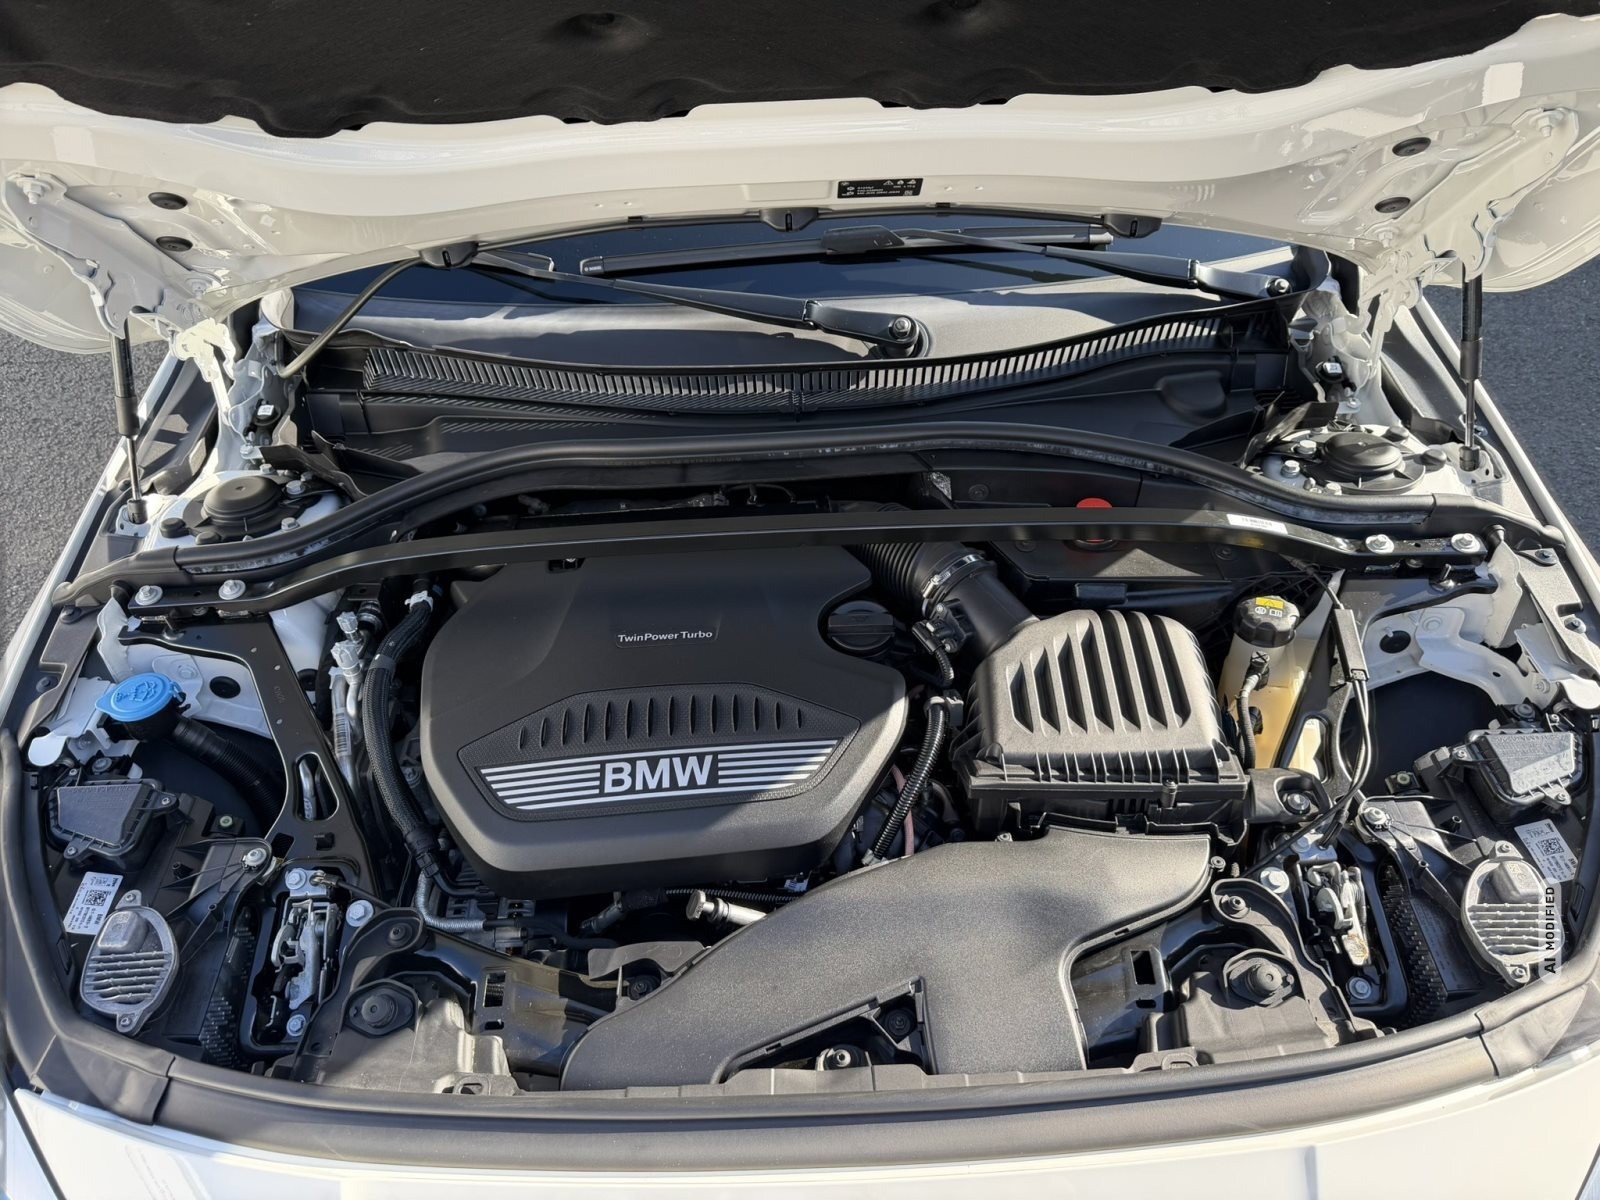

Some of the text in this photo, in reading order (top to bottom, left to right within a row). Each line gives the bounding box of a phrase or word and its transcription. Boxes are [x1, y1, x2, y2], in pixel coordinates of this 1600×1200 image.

[618, 630, 713, 643] TwinPower Turbo
[604, 754, 713, 794] BMW
